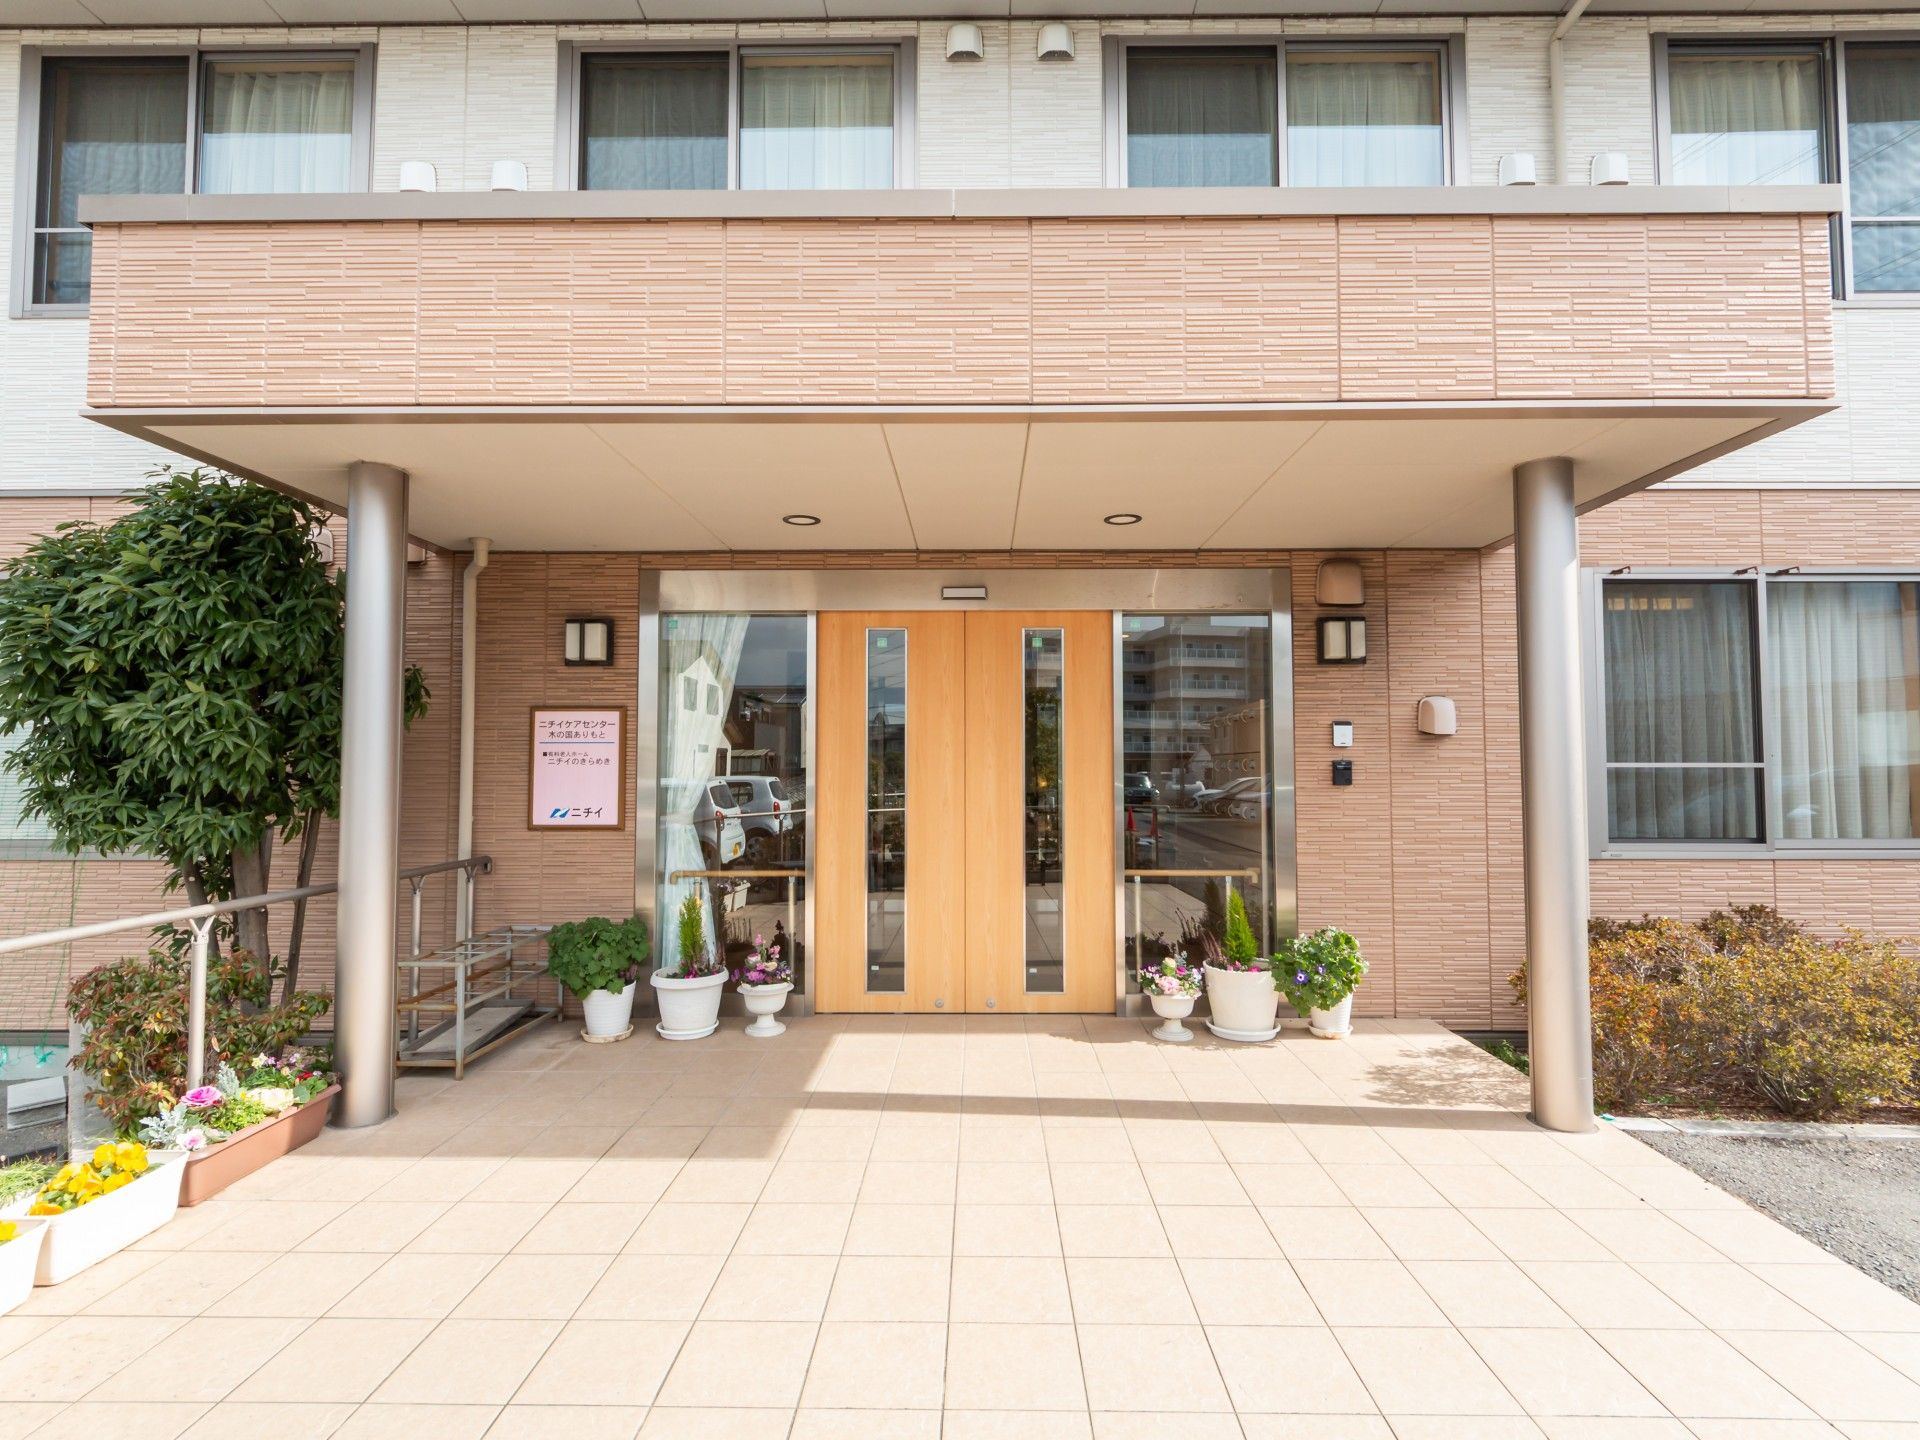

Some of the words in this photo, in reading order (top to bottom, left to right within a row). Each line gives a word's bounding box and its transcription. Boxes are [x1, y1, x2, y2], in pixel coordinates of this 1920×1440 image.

[538, 720, 616, 729] ニチイケアセンター
[548, 730, 606, 739] 木の国ありもと
[548, 758, 611, 766] ニチイのきらめき
[571, 807, 603, 818] ニチイ
